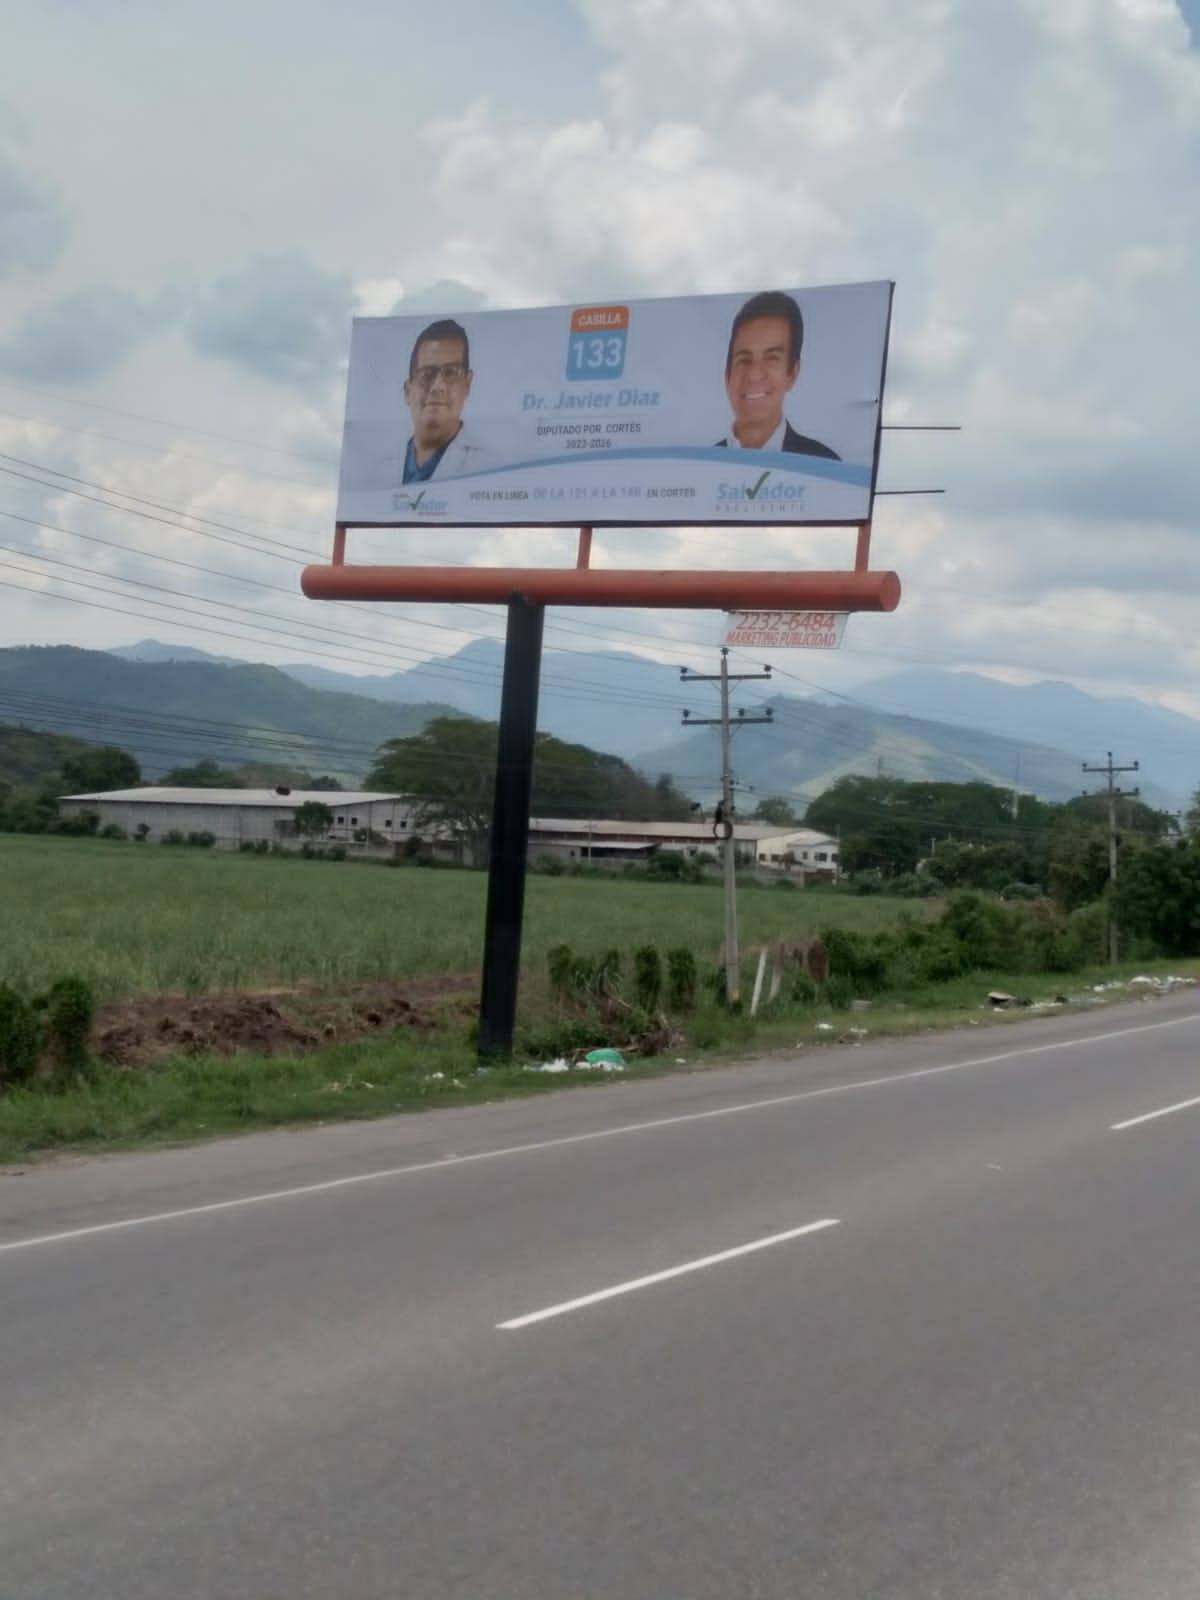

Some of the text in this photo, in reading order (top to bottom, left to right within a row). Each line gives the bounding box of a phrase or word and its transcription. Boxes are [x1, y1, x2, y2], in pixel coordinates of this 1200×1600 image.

[578, 313, 622, 327] CASILLA
[572, 336, 624, 369] 133
[522, 393, 548, 411] Dr.
[551, 391, 613, 410] Javier
[536, 424, 583, 436] DIPUTADO
[583, 423, 602, 434] POR
